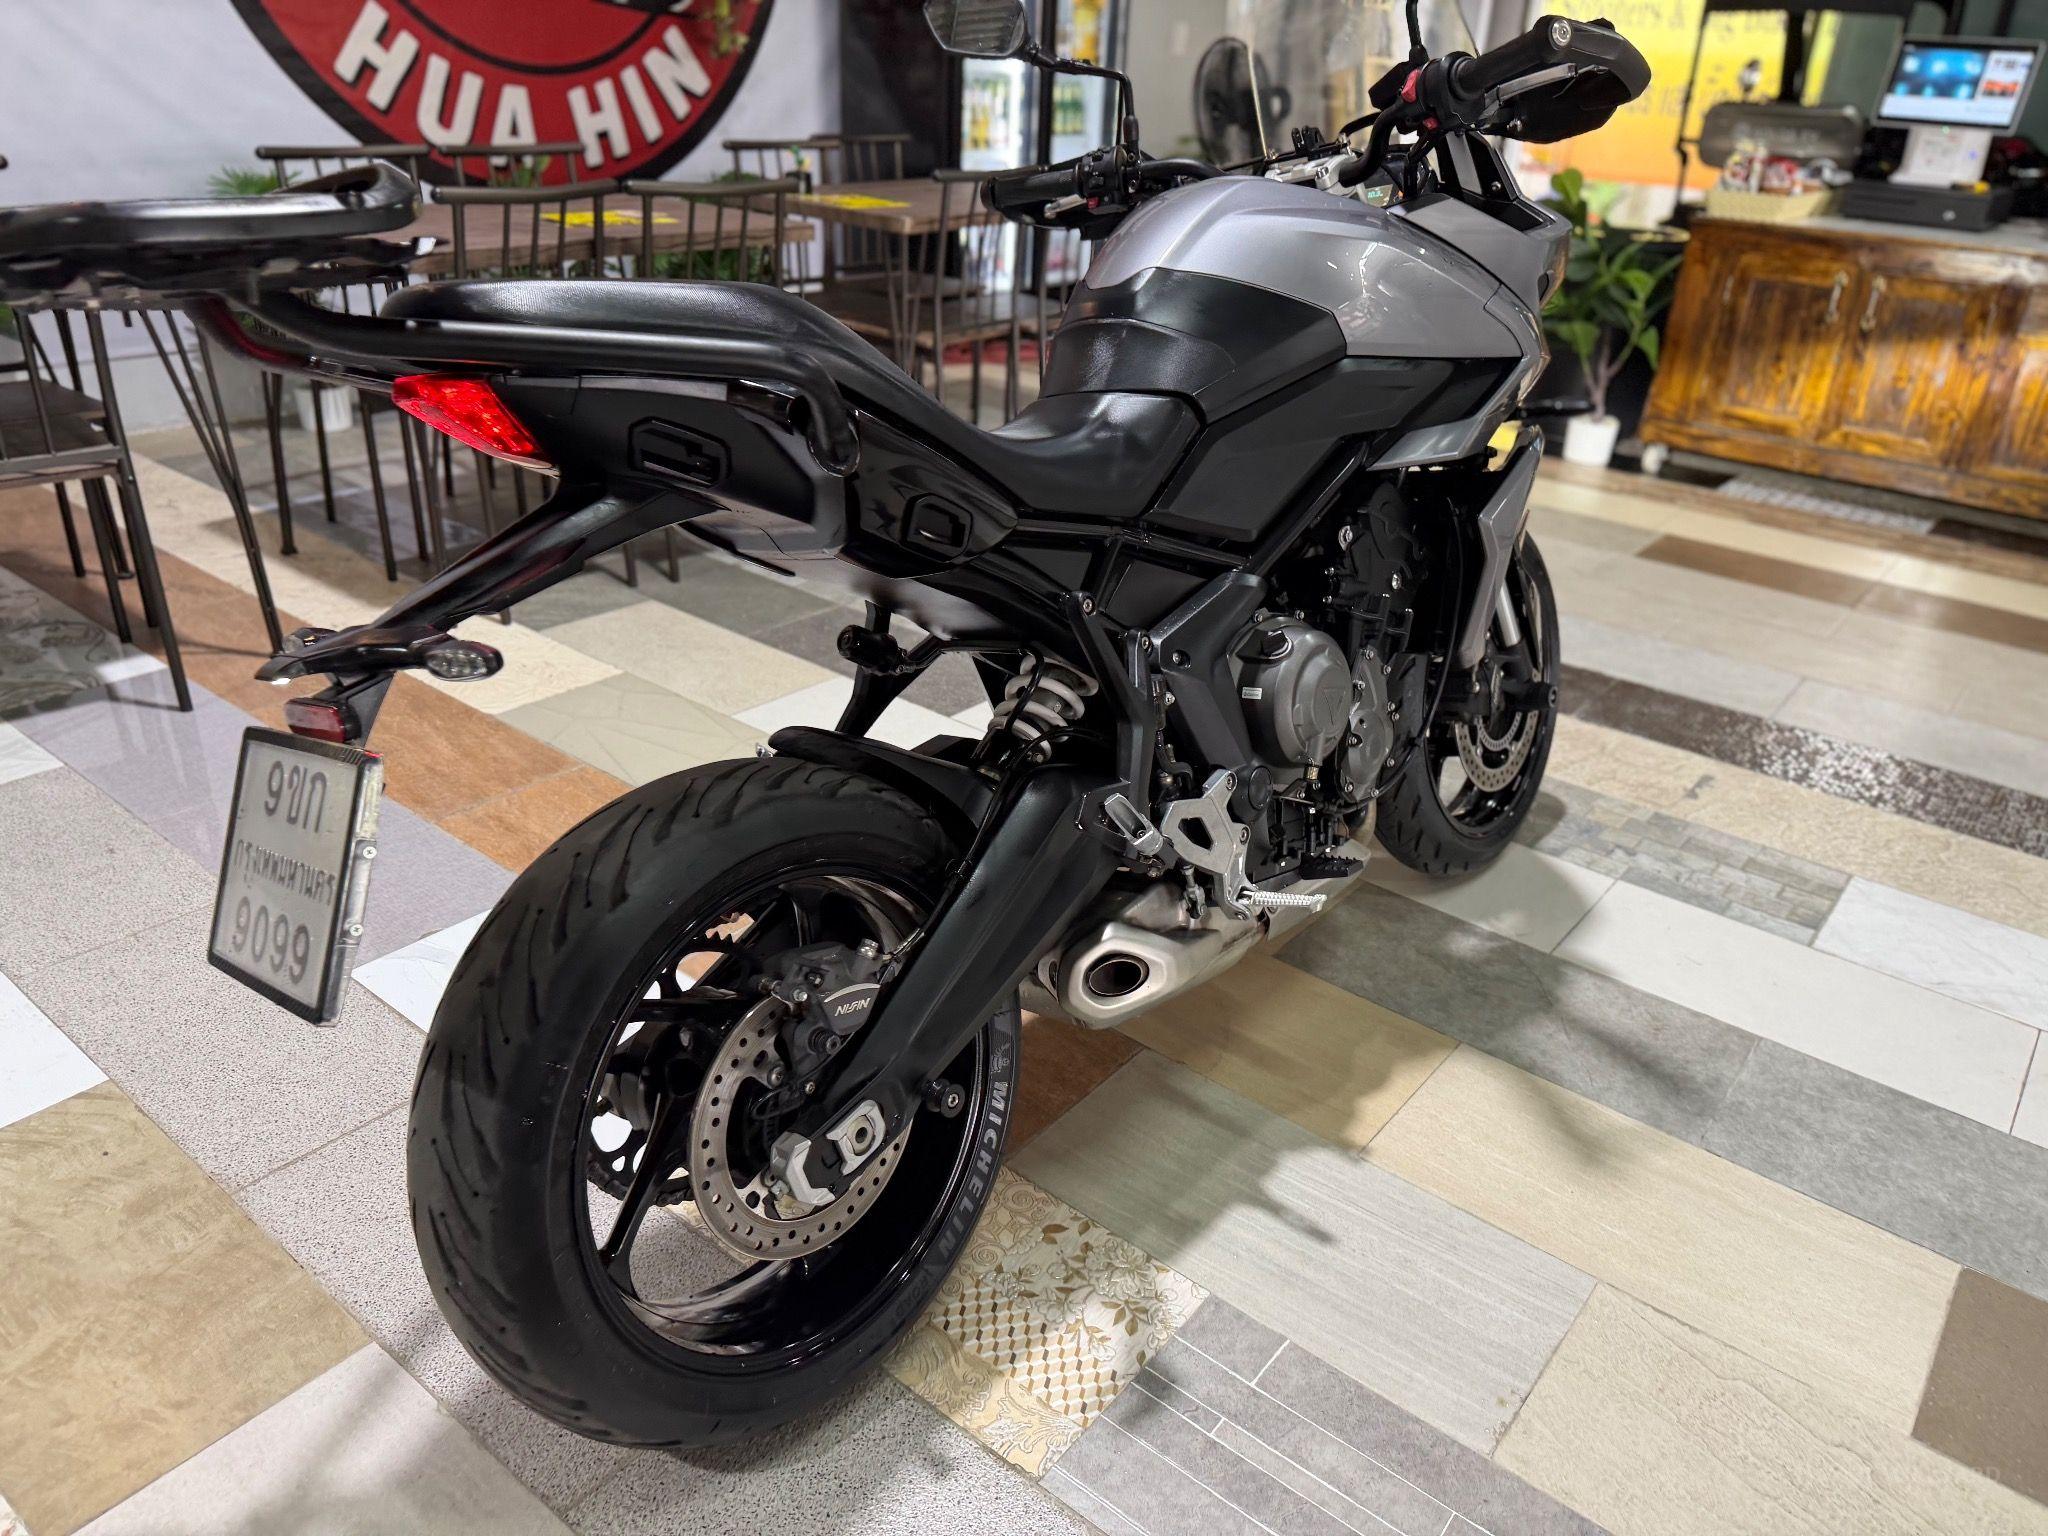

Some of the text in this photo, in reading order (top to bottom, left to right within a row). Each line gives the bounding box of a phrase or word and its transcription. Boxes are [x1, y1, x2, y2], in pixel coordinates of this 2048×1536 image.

[333, 0, 711, 168] HUA HIN
[232, 896, 311, 985] 9099
[938, 1080, 1009, 1260] MICHELIN
